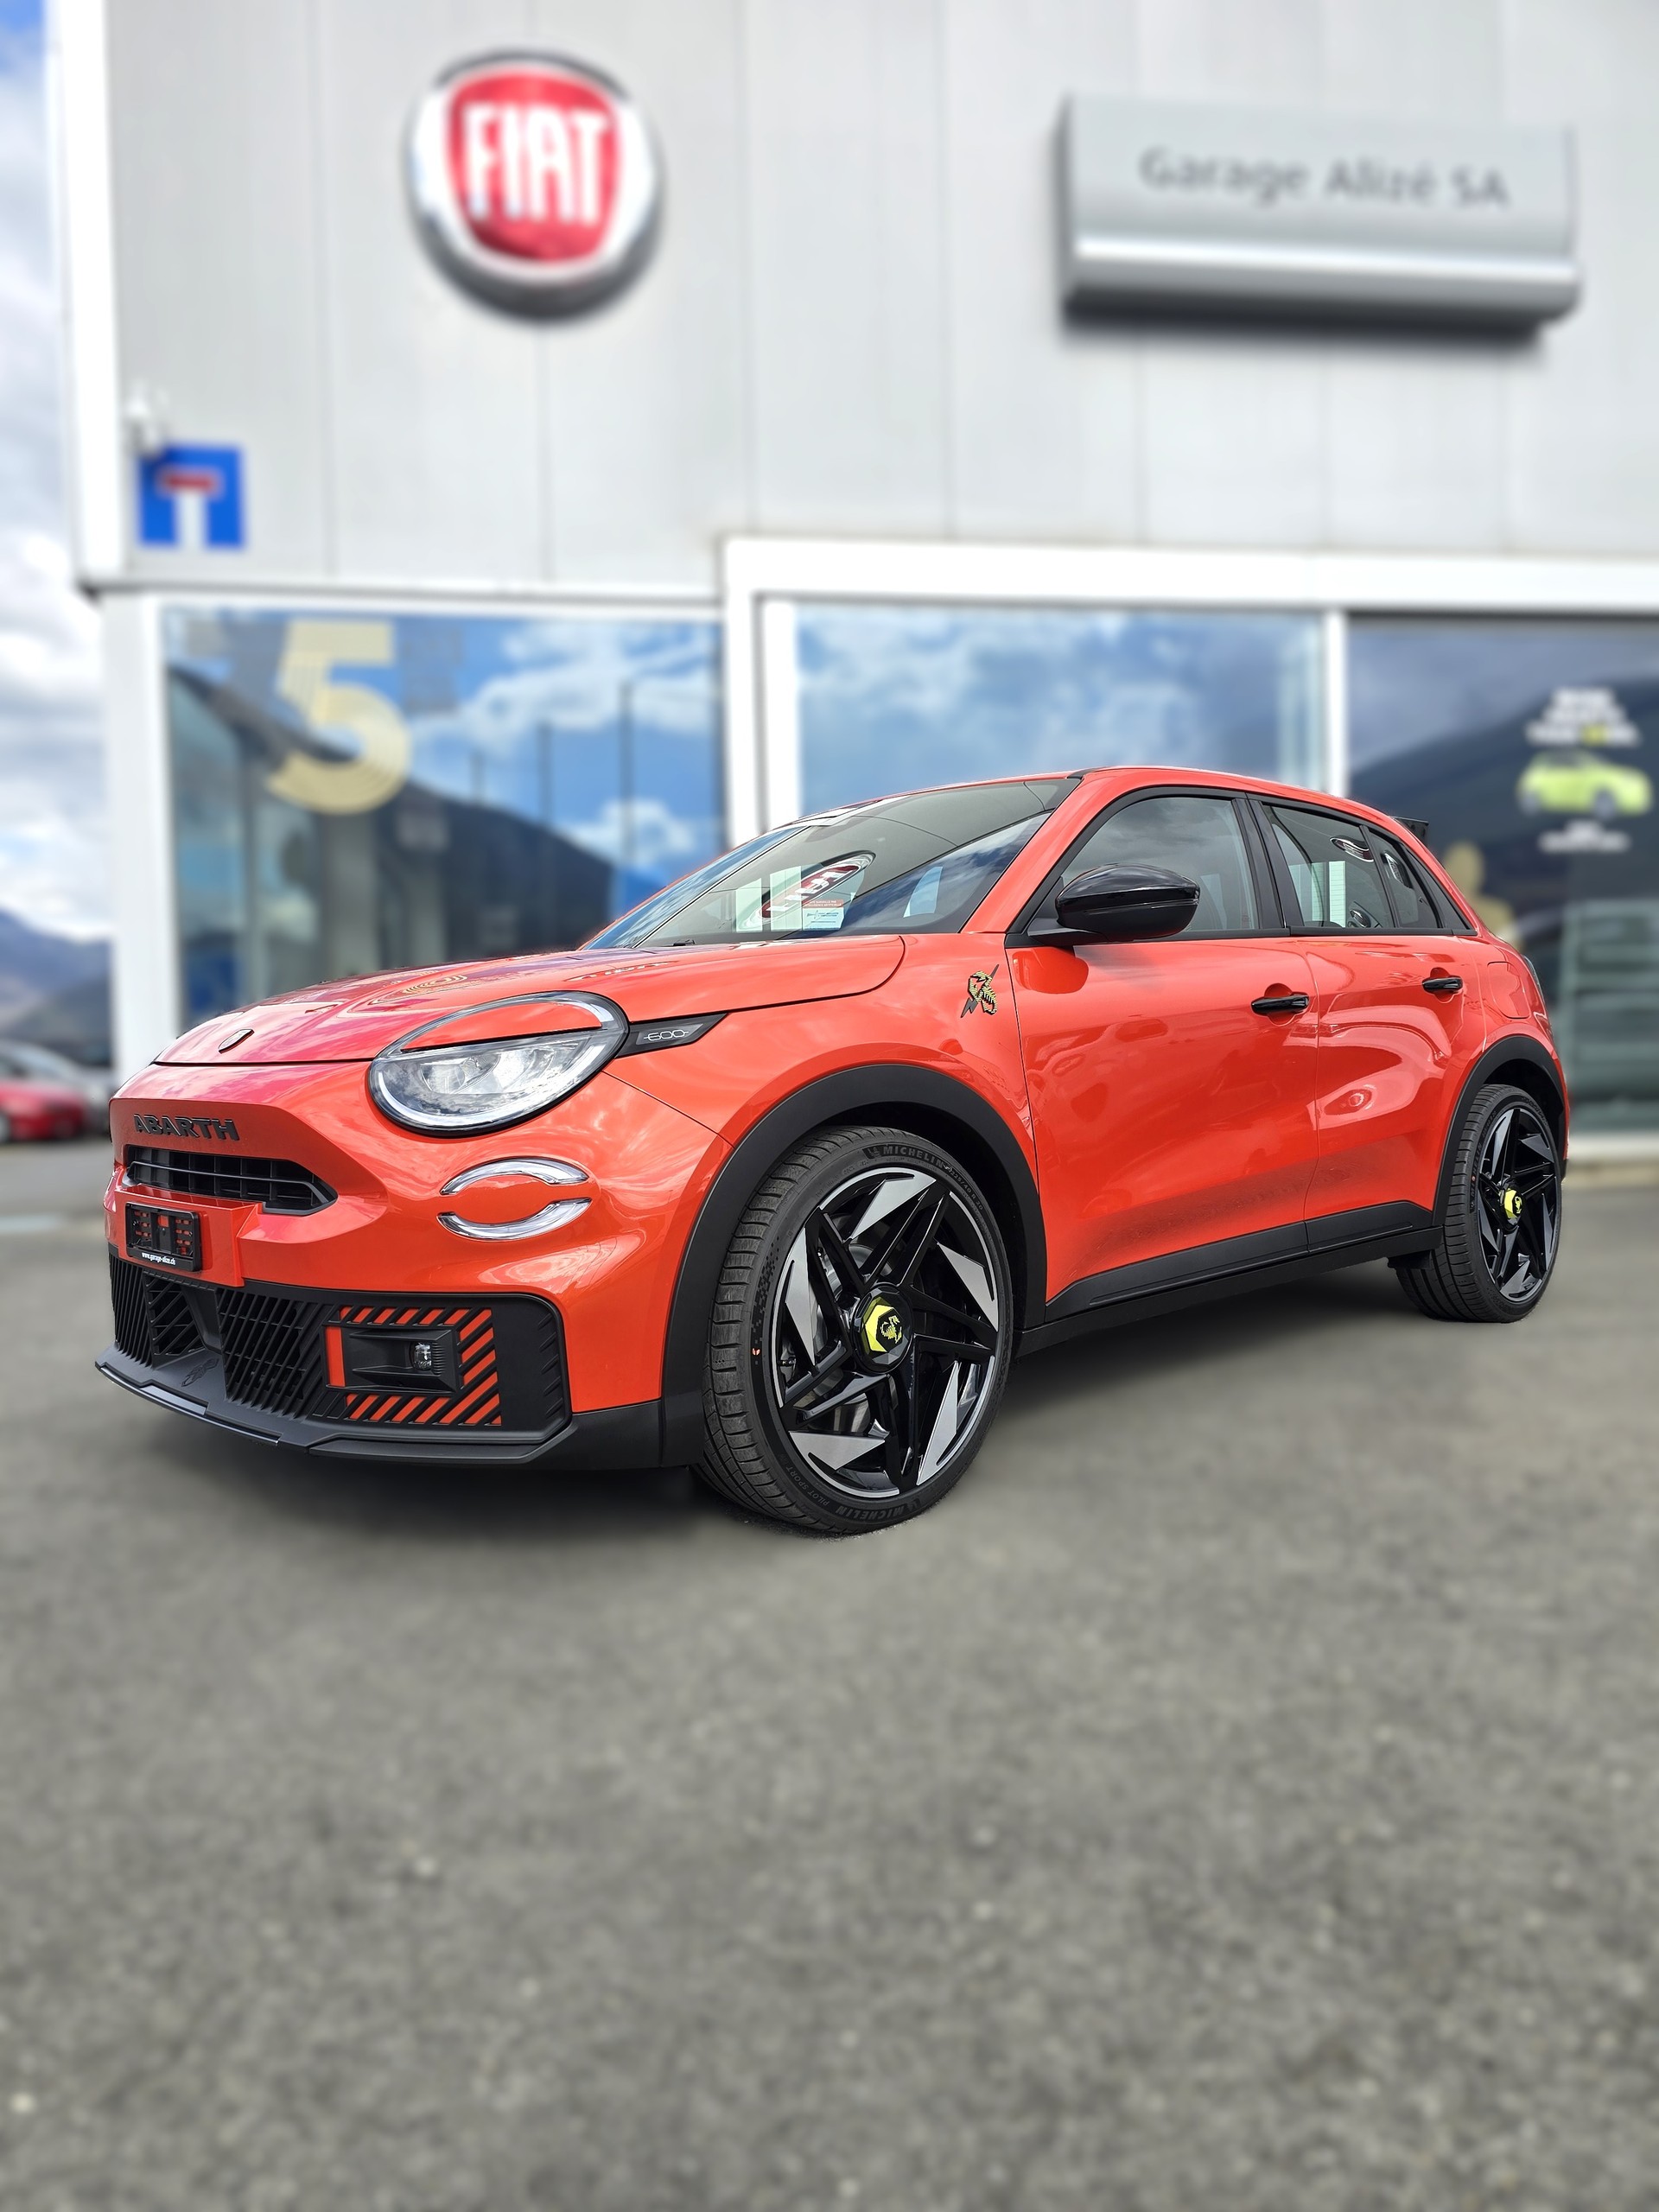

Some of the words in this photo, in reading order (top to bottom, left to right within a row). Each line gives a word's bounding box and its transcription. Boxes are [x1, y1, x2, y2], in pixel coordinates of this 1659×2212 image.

[461, 102, 609, 226] FIAT
[1139, 145, 1310, 209] Garage
[1325, 156, 1438, 206] Alizé
[1450, 167, 1511, 208] SA
[133, 1113, 240, 1141] ABARTH
[883, 1146, 944, 1167] MICHELIN
[787, 1466, 809, 1491] SPORT
[807, 1490, 830, 1507] PILOT
[836, 1505, 905, 1521] MICHELIN
